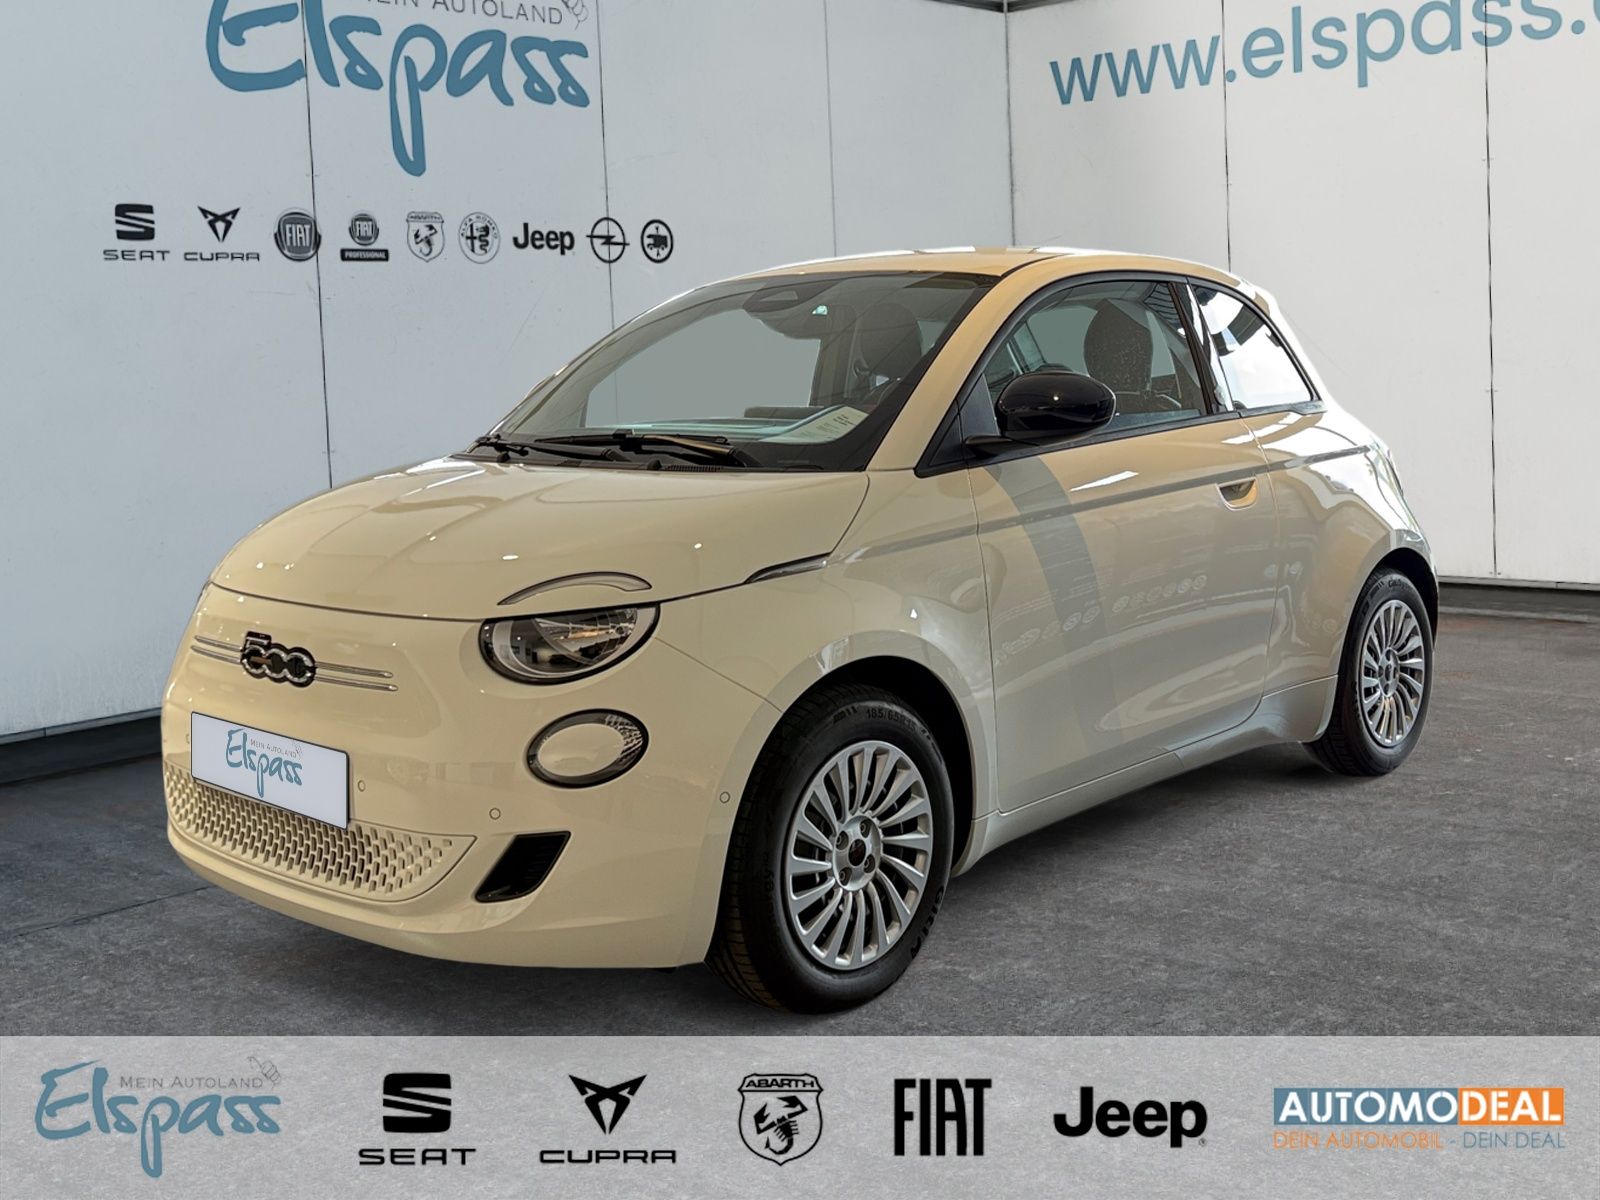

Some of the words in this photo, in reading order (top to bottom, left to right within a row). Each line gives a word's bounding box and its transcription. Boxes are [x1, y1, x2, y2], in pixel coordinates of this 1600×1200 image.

[1049, 0, 1600, 105] www.elspass.
[206, 0, 590, 177] Elspass
[103, 250, 170, 261] SEAT
[184, 252, 260, 261] CUPRA
[285, 223, 311, 247] FIAT
[512, 222, 575, 256] Jeep
[241, 631, 315, 687] 500
[226, 728, 302, 798] Elspass
